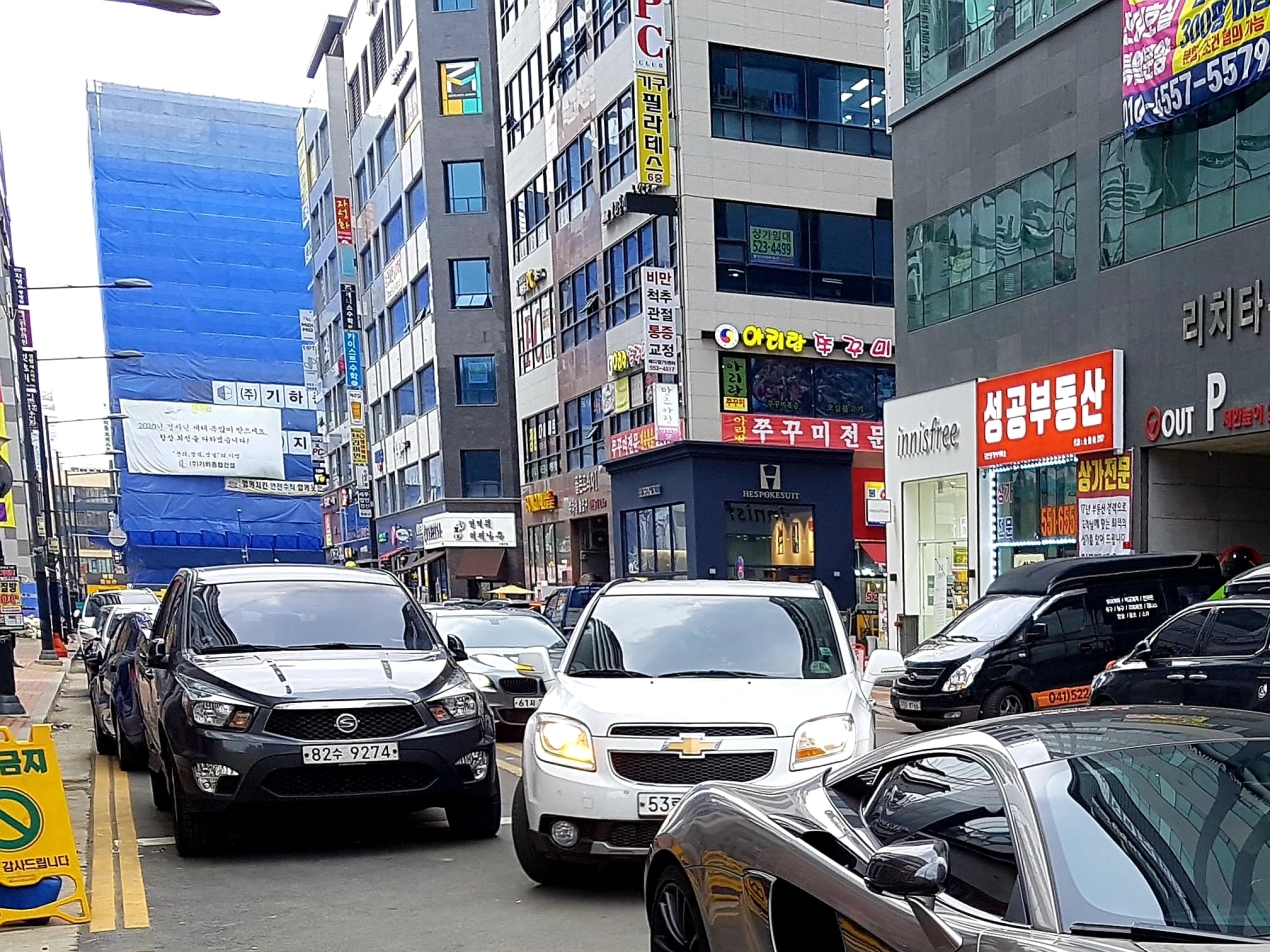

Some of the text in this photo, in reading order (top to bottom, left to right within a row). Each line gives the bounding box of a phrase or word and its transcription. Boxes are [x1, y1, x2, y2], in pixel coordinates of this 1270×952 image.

[1223, 25, 1244, 46] 협의
[1244, 15, 1265, 37] 가능
[638, 60, 664, 69] CLUB
[637, 75, 666, 92] 기구
[642, 93, 664, 173] 필라테스
[752, 228, 791, 243] 상가임대
[646, 271, 671, 285] 비만
[647, 288, 672, 304] 척추
[647, 307, 673, 322] 관절
[648, 325, 674, 339] 통증
[741, 325, 807, 352] 아리랑
[649, 344, 674, 357] 교정
[727, 361, 744, 398] 아리랑
[983, 367, 1106, 444] 성공부동산
[1207, 372, 1227, 432] P
[1161, 406, 1195, 438] OUT
[751, 418, 884, 450] 쭈꾸미전문
[897, 416, 960, 457] innisfree
[1078, 456, 1130, 492] 상가전문
[1092, 503, 1106, 515] 부동산
[311, 745, 390, 761] 82수 9274
[2, 855, 70, 873] 감사드립니다
